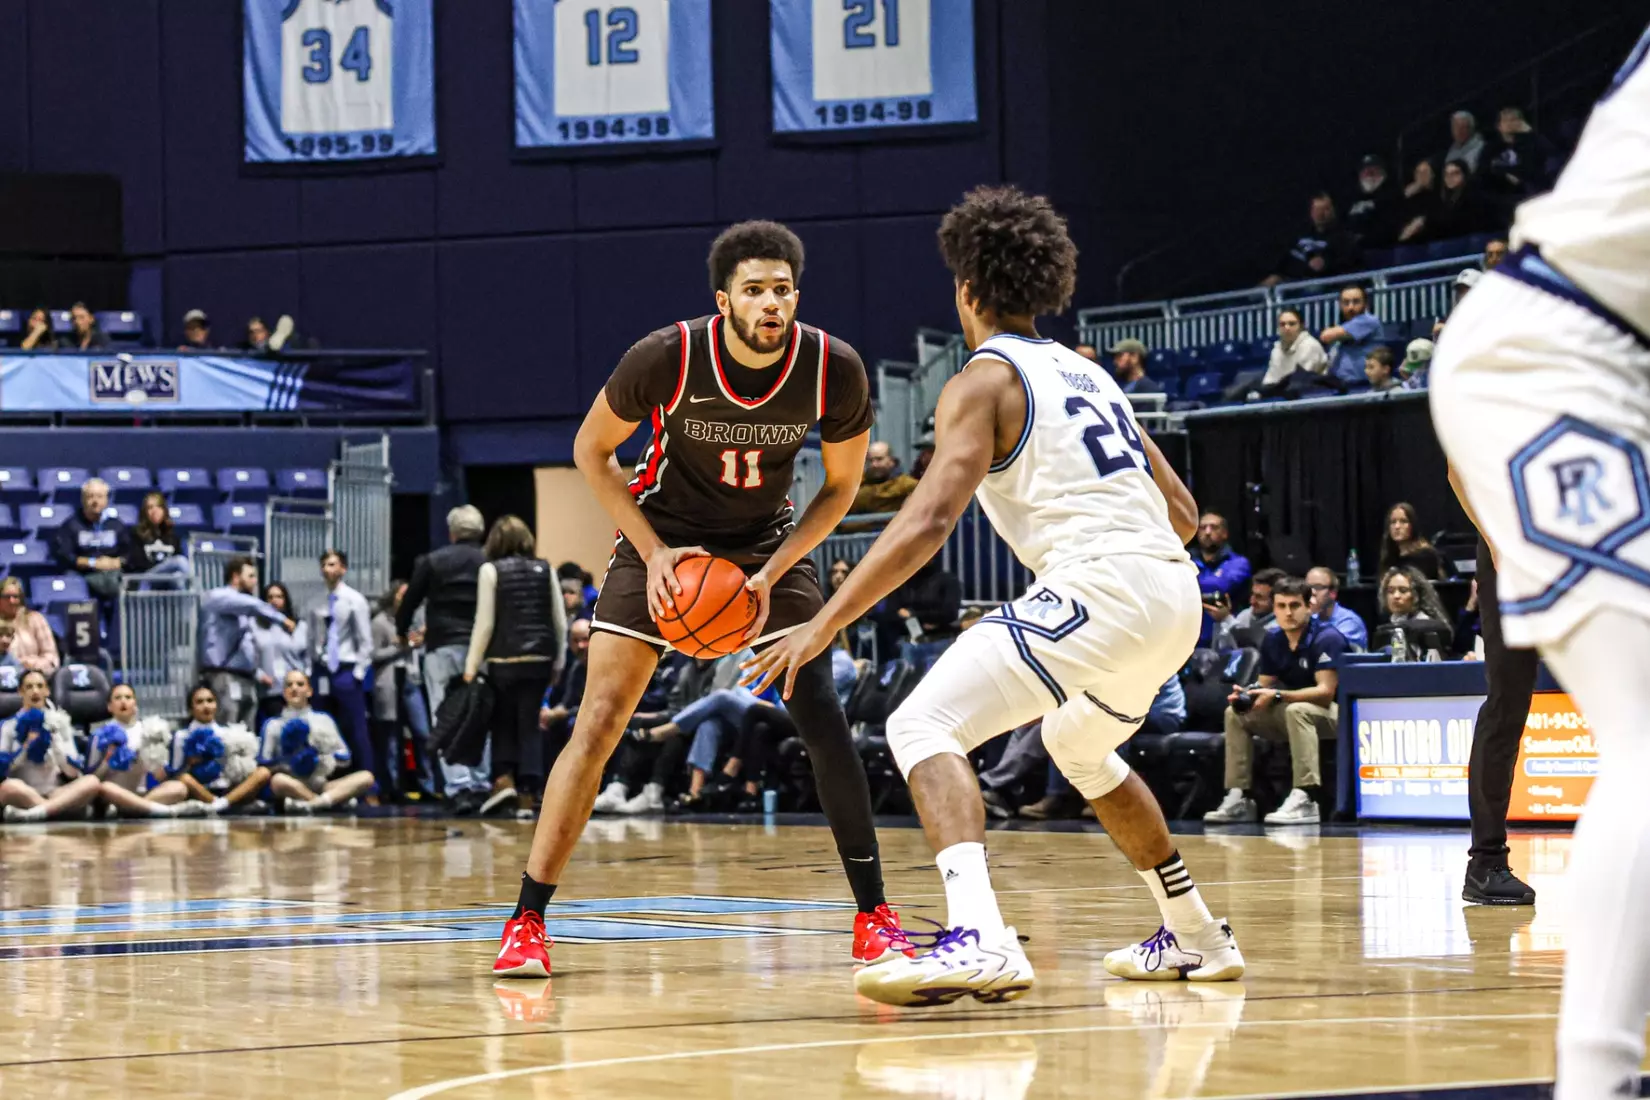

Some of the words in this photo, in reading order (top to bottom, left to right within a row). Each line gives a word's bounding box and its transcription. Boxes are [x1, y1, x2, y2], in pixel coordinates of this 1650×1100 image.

[584, 7, 639, 66] 12
[842, 0, 899, 49] 21
[302, 26, 372, 84] 34
[684, 418, 808, 445] BROWN
[1063, 396, 1154, 480] 24
[719, 449, 764, 489] 11
[76, 621, 91, 648] 5
[1359, 719, 1442, 765] SANTORO
